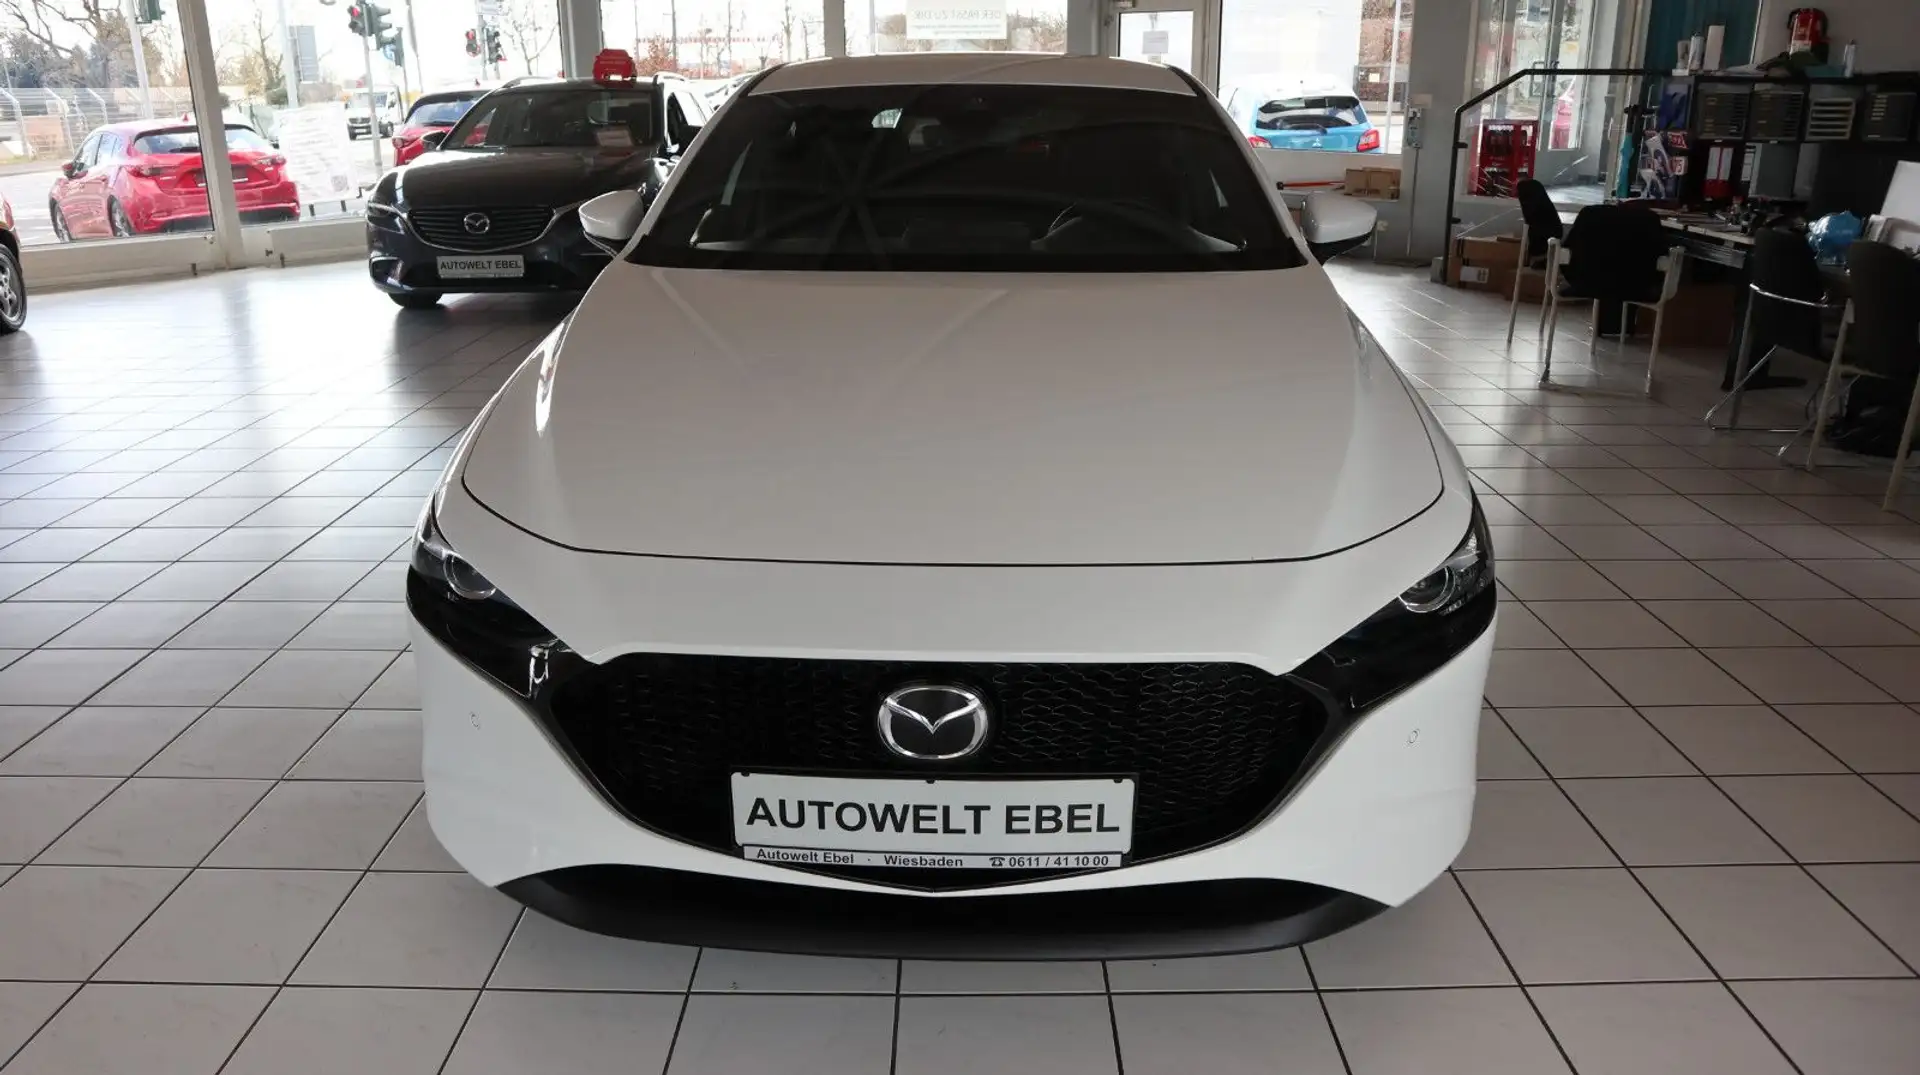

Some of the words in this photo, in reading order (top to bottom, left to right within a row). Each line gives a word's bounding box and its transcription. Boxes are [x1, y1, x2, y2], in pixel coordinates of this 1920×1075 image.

[440, 260, 492, 270] AUTOWELT
[495, 259, 522, 269] EBEL
[746, 797, 991, 835] AUTOWELT
[1005, 803, 1120, 835] EBEL
[756, 848, 819, 863] Autowelt
[823, 852, 854, 864] Ebel
[884, 854, 963, 867] Wiesbaden
[1008, 856, 1040, 867] 0611
[1053, 856, 1069, 867] 41
[1075, 856, 1090, 867] 10
[1092, 856, 1109, 867] 00
